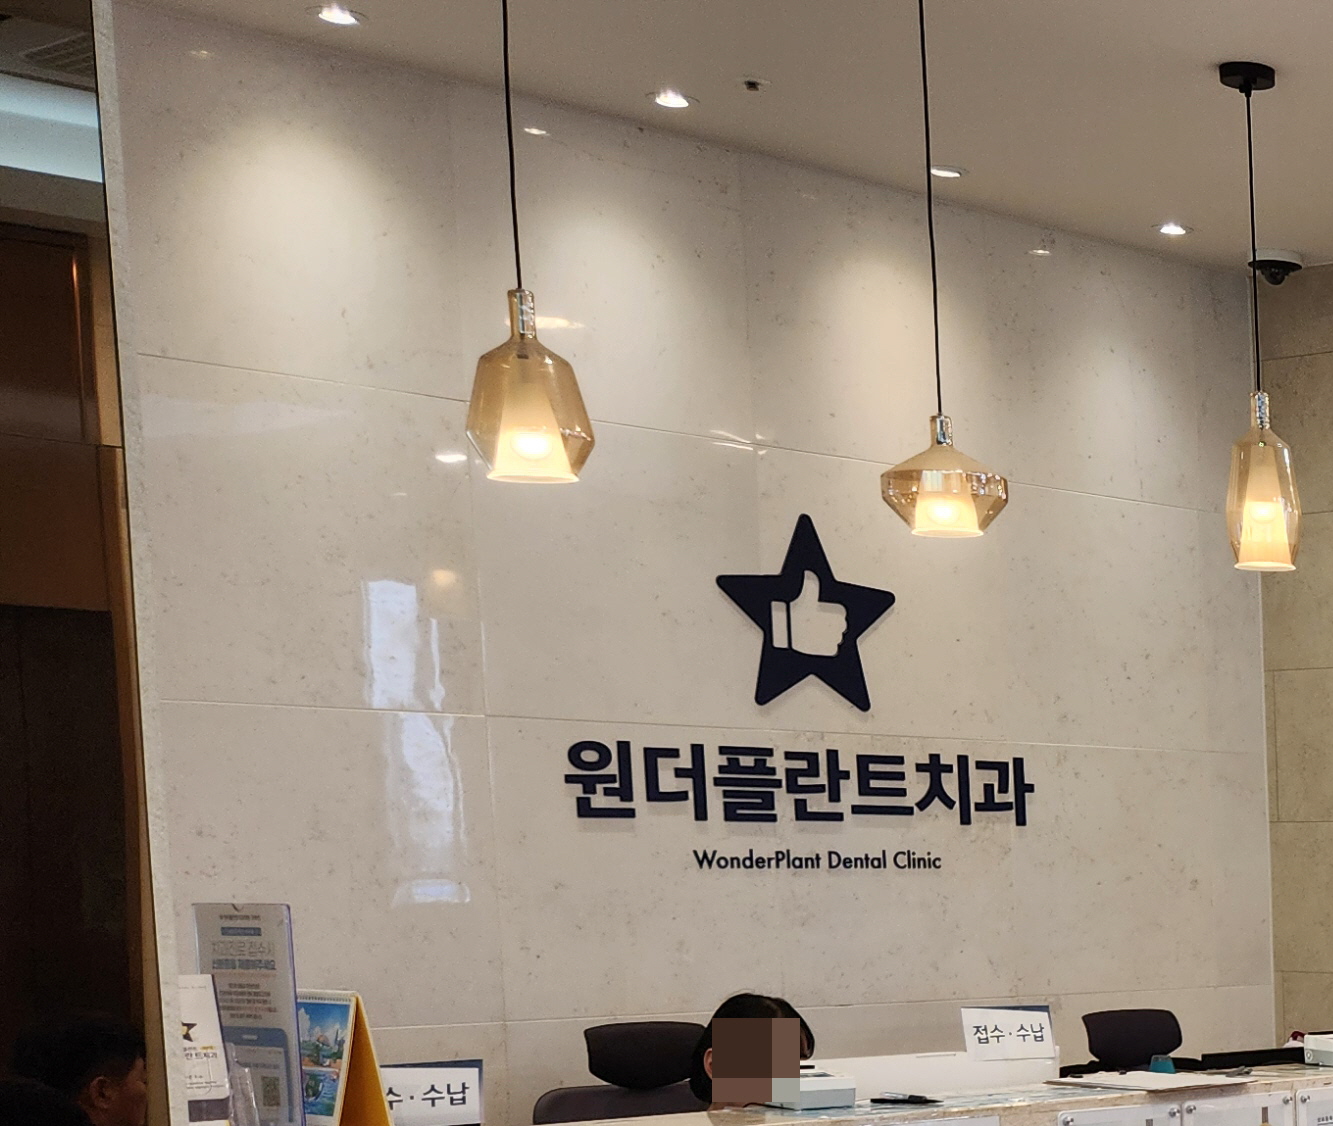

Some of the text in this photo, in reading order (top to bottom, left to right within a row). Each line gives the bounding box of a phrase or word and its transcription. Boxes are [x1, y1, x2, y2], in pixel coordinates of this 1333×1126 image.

[564, 739, 1035, 827] 원더플란트치과
[693, 850, 942, 870] WonderPlant Dental Clinic
